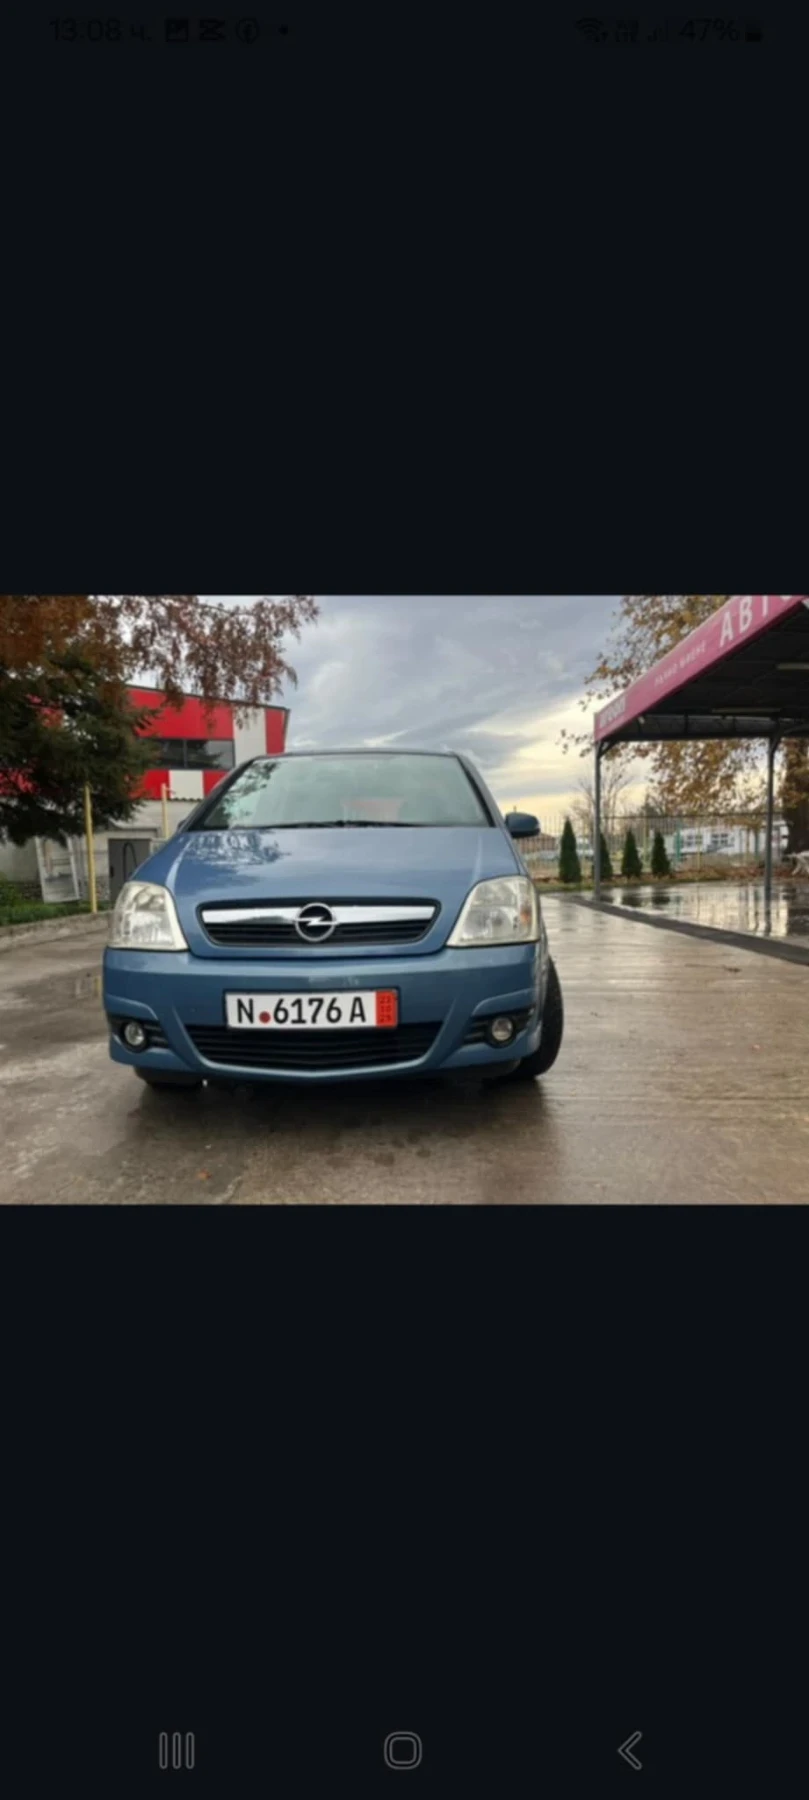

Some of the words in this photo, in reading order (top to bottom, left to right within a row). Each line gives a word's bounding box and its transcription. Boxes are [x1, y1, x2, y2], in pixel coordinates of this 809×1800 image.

[237, 998, 254, 1024] N
[273, 997, 342, 1024] 6176
[349, 997, 366, 1024] A
